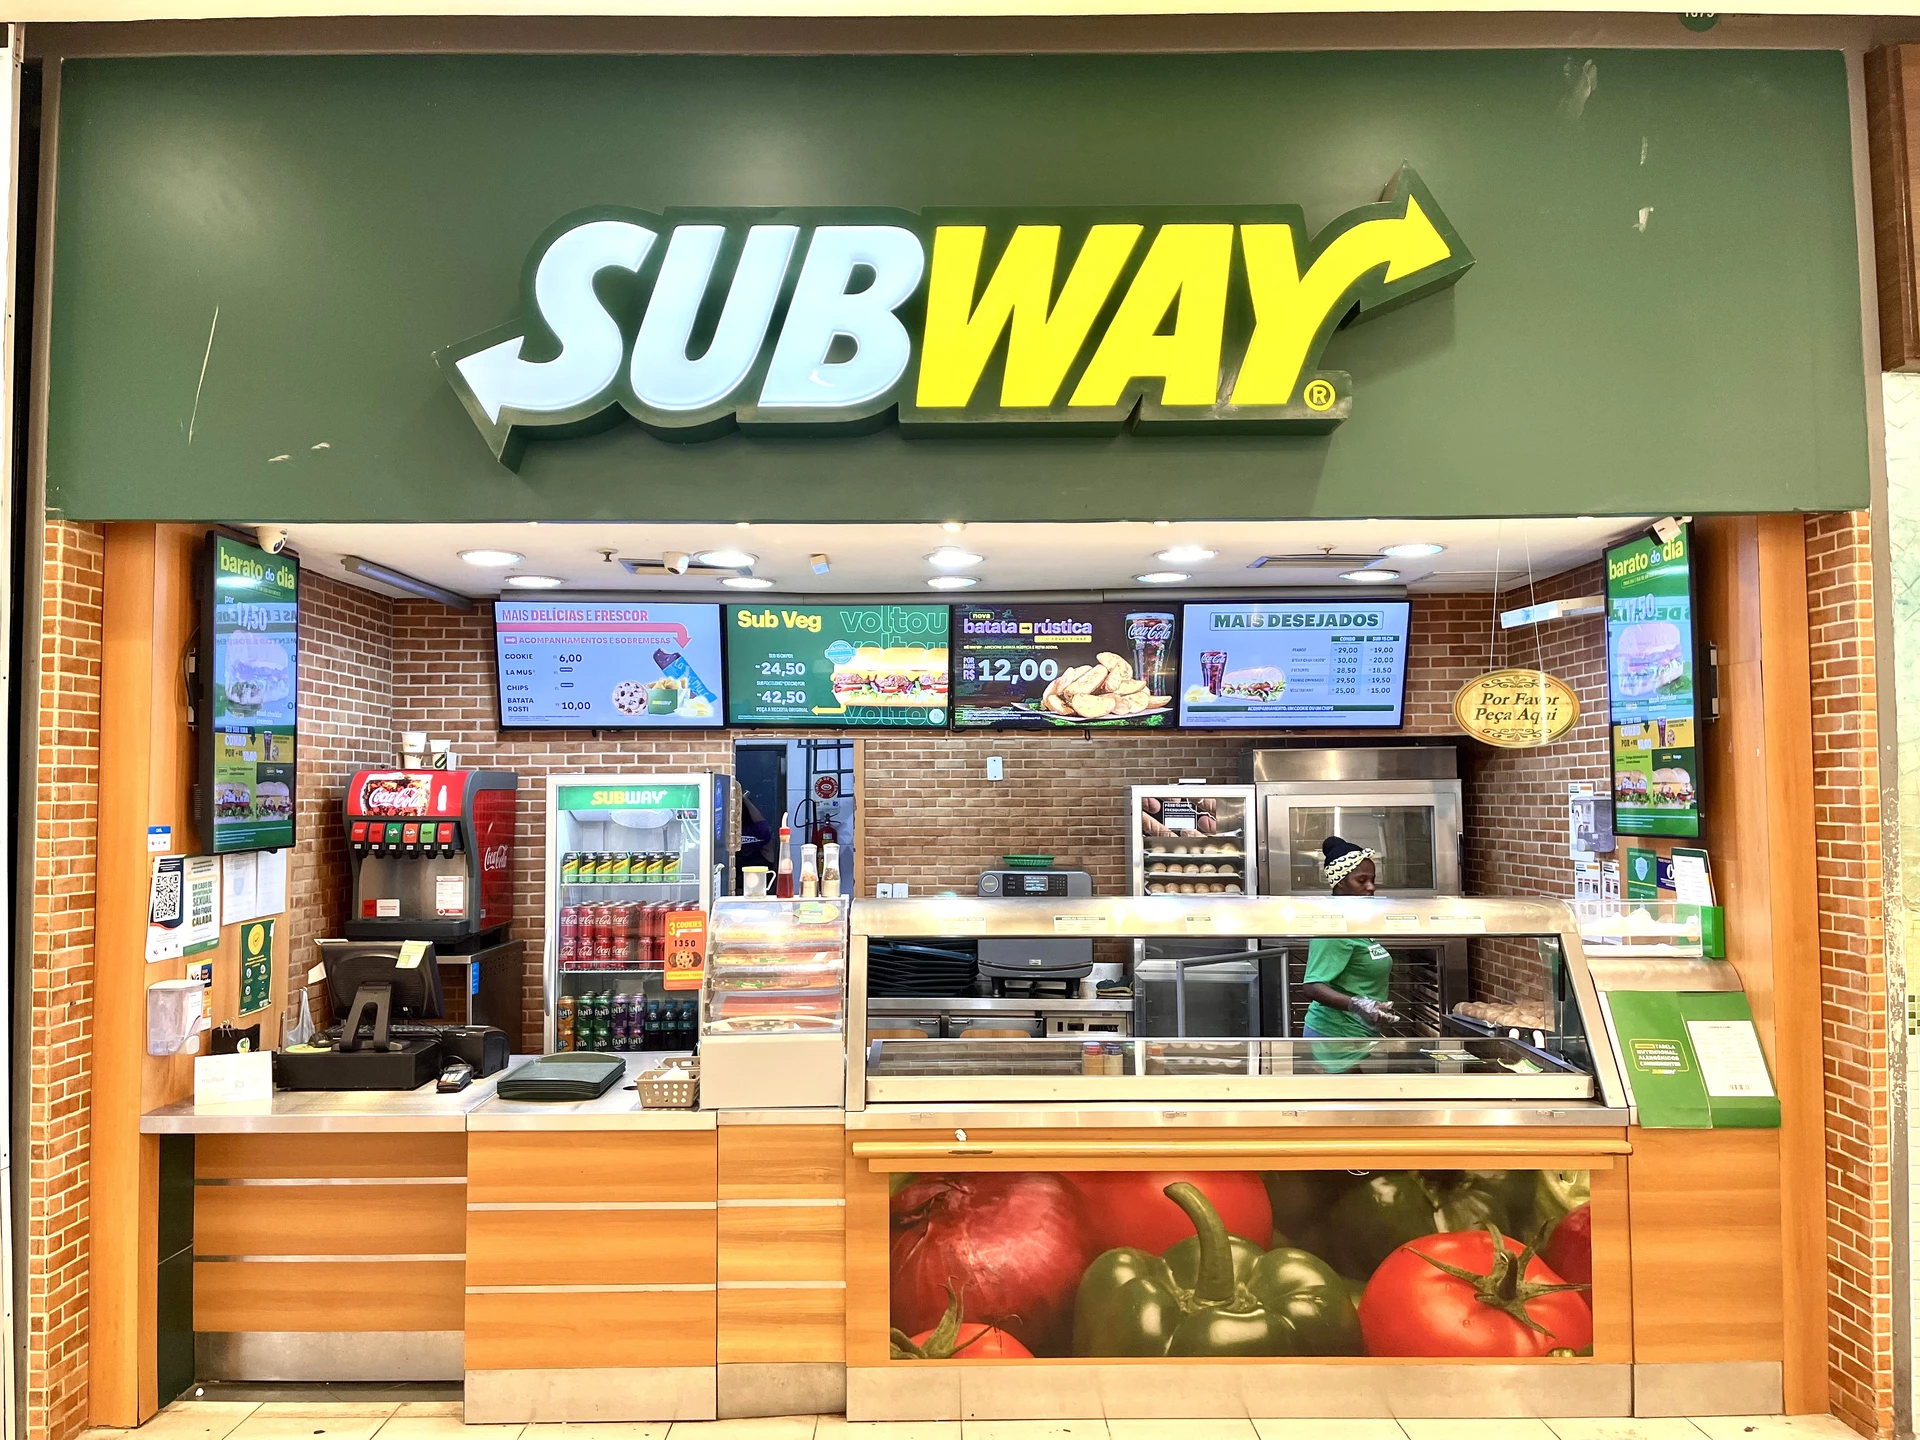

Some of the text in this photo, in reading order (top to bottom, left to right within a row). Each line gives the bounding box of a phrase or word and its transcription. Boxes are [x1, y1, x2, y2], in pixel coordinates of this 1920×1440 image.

[455, 195, 1451, 426] SUBWAY
[1609, 553, 1648, 580] barato
[1650, 550, 1660, 564] do
[1662, 540, 1684, 562] dia
[220, 547, 295, 589] barato do dia
[502, 607, 649, 622] MAIS DELÍCIAS E FRESCOR
[737, 609, 822, 632] Sub Veg
[840, 605, 948, 635] voltou
[1214, 613, 1379, 628] MAIS DESEJADOS
[963, 618, 1093, 634] batata rústica
[559, 654, 582, 663] 6,00
[761, 662, 806, 677] 24,50
[963, 658, 1059, 685] R$ 12,00
[761, 691, 806, 705] 42,50
[1480, 692, 1510, 706] Por
[562, 701, 591, 711] 10,00
[1474, 708, 1512, 725] Peça
[589, 789, 668, 806] SUBWAY
[192, 895, 212, 907] SEXUAL
[192, 905, 212, 916] NÃO FIQUE
[192, 914, 213, 927] CALADA
[668, 920, 703, 936] 3 COOKIES
